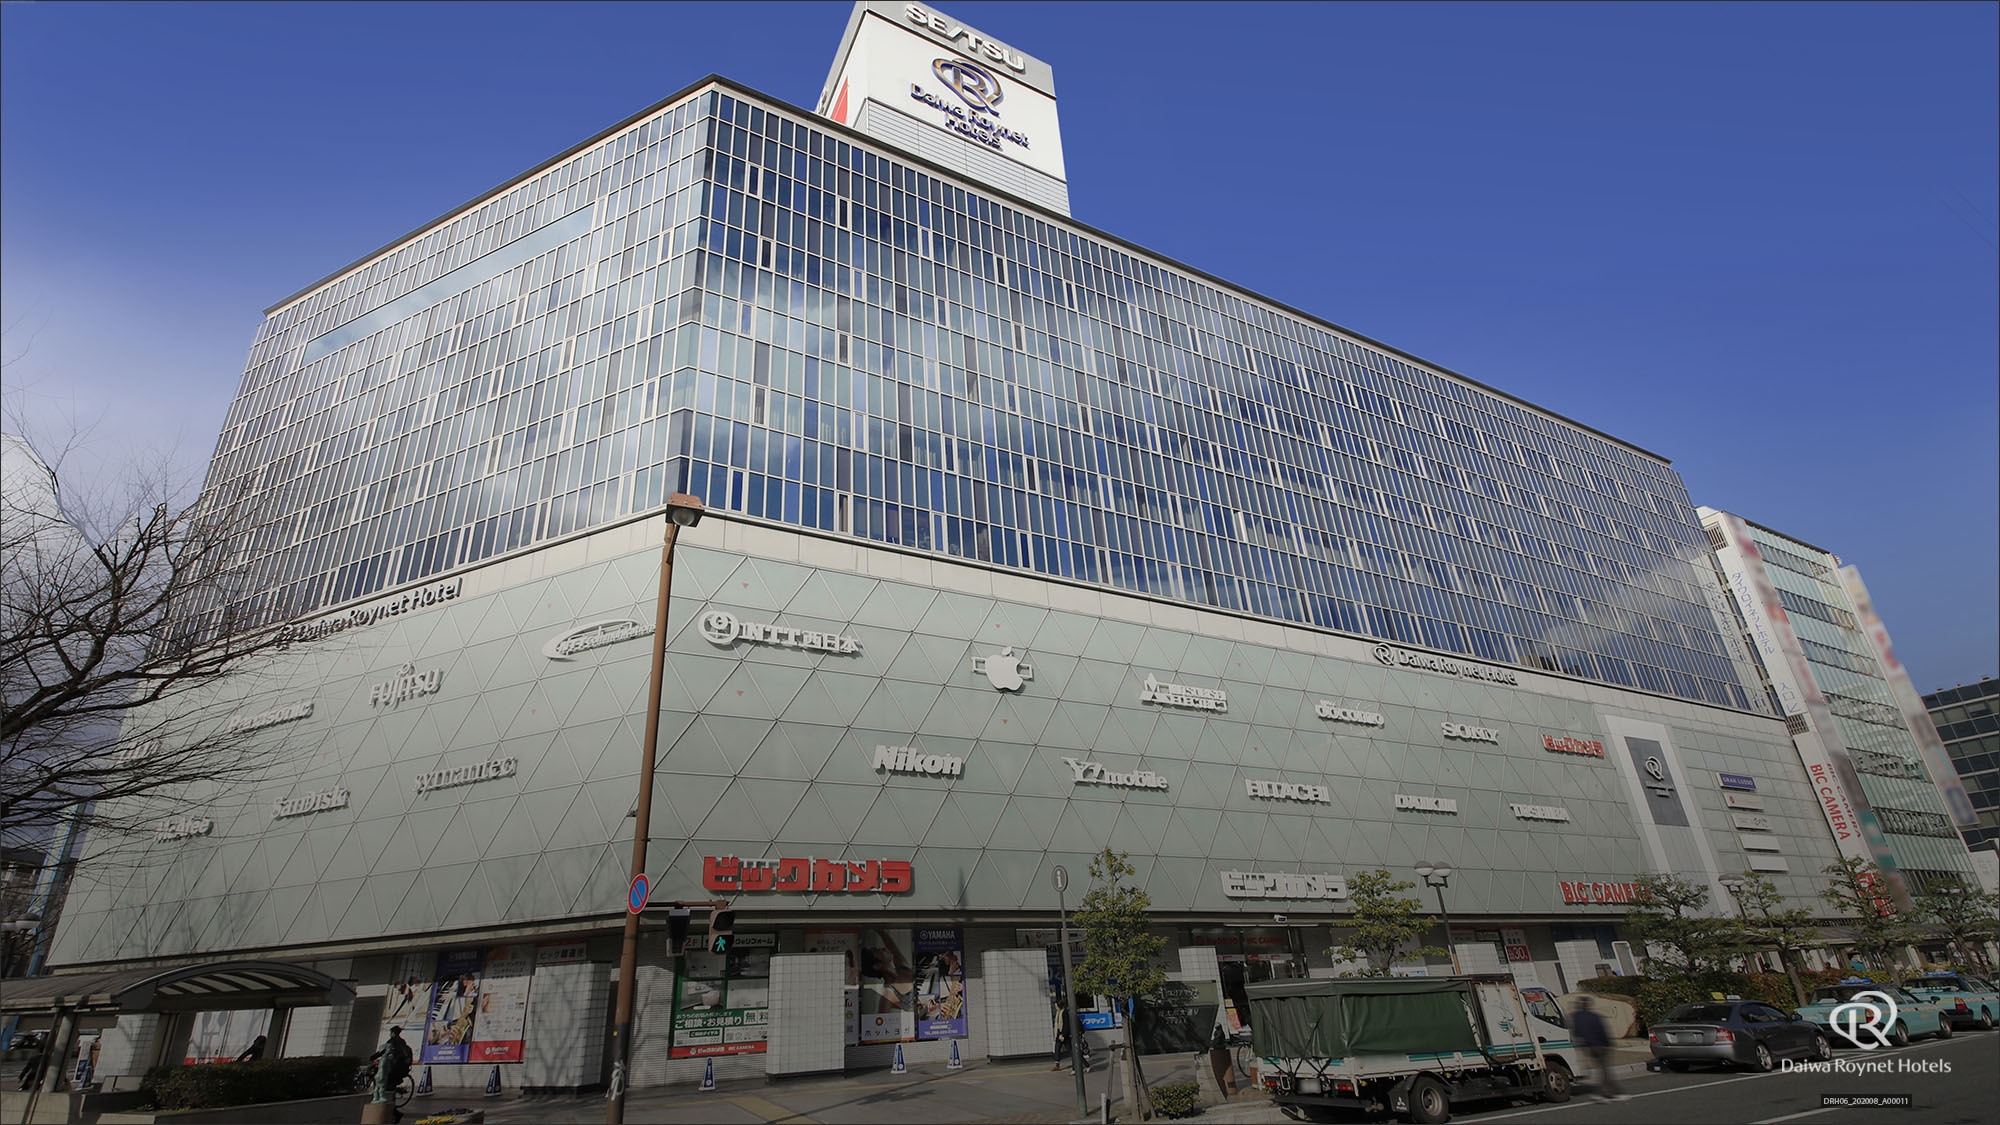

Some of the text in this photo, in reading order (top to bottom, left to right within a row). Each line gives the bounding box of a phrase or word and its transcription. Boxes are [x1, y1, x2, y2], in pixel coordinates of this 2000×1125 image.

[911, 83, 1029, 149] Daiwa Roynet
[347, 597, 409, 628] Roynet
[410, 577, 463, 609] Hotel
[1399, 649, 1518, 685] Daiwa Roynet Hotel
[368, 669, 444, 711] FUJITSU
[1315, 704, 1384, 725] docomo
[1441, 721, 1499, 743] SONY
[873, 745, 963, 775] Nikon
[413, 756, 518, 797] symantec
[1245, 779, 1330, 802] HITACHI
[273, 786, 350, 820] SanDisk
[1394, 794, 1457, 813] DAIKIN
[1511, 803, 1569, 821] TOSHIBA
[1810, 764, 1851, 840] BIC CAMERA
[703, 856, 911, 892] ビックカメラ
[1220, 871, 1347, 899] ビックカメラ
[1560, 882, 1589, 903] BIC
[928, 930, 955, 940] YAMAHA
[675, 1016, 742, 1029] ご相談・お見積り
